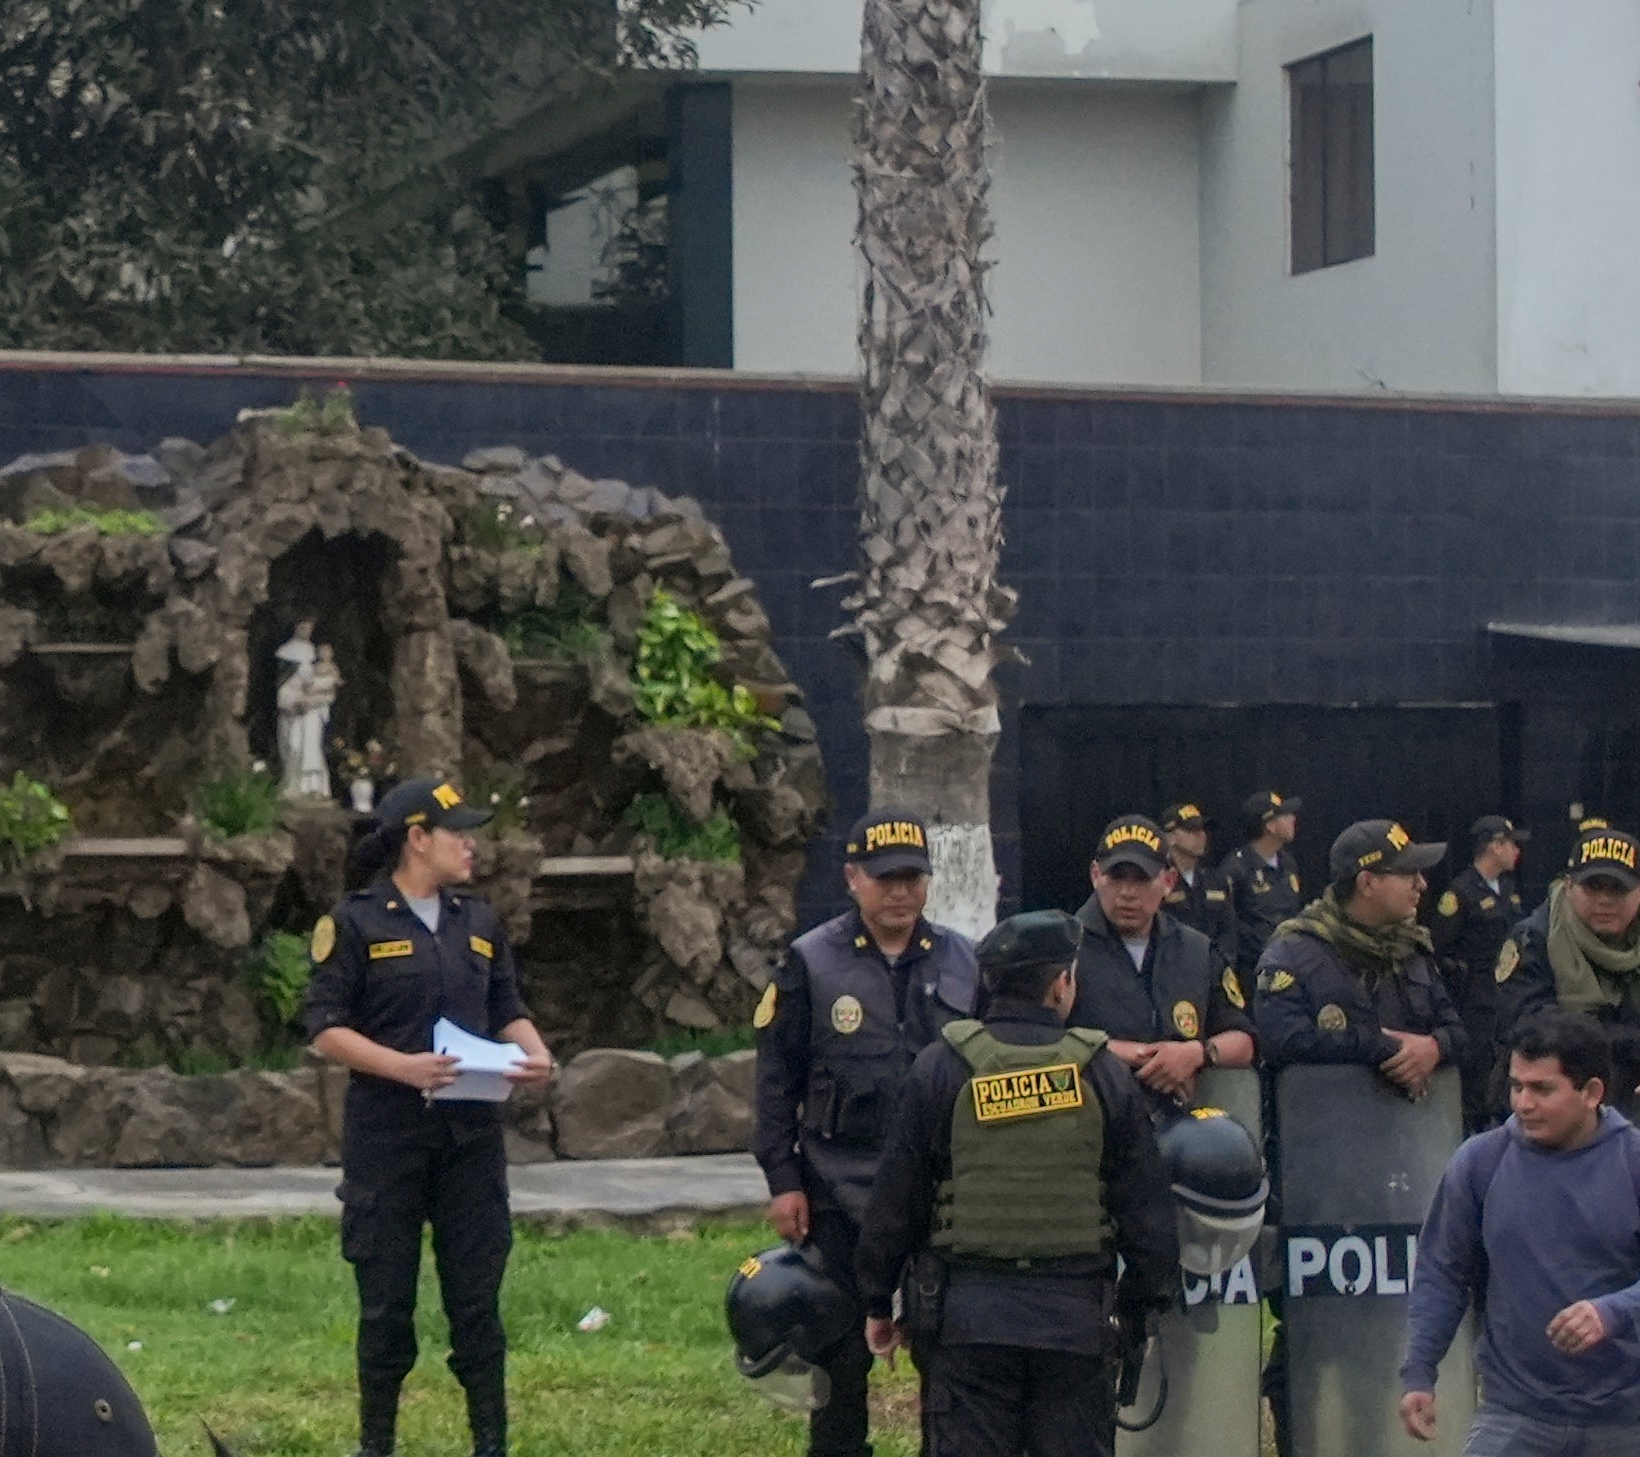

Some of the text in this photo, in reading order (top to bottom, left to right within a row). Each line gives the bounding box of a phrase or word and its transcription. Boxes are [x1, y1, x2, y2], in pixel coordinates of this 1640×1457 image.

[866, 821, 924, 851] POLICIA
[1105, 824, 1161, 852] POLICIA
[1580, 836, 1636, 869] POLICIA
[977, 1073, 1052, 1103] POLICIA
[1043, 1089, 1076, 1106] VERDE
